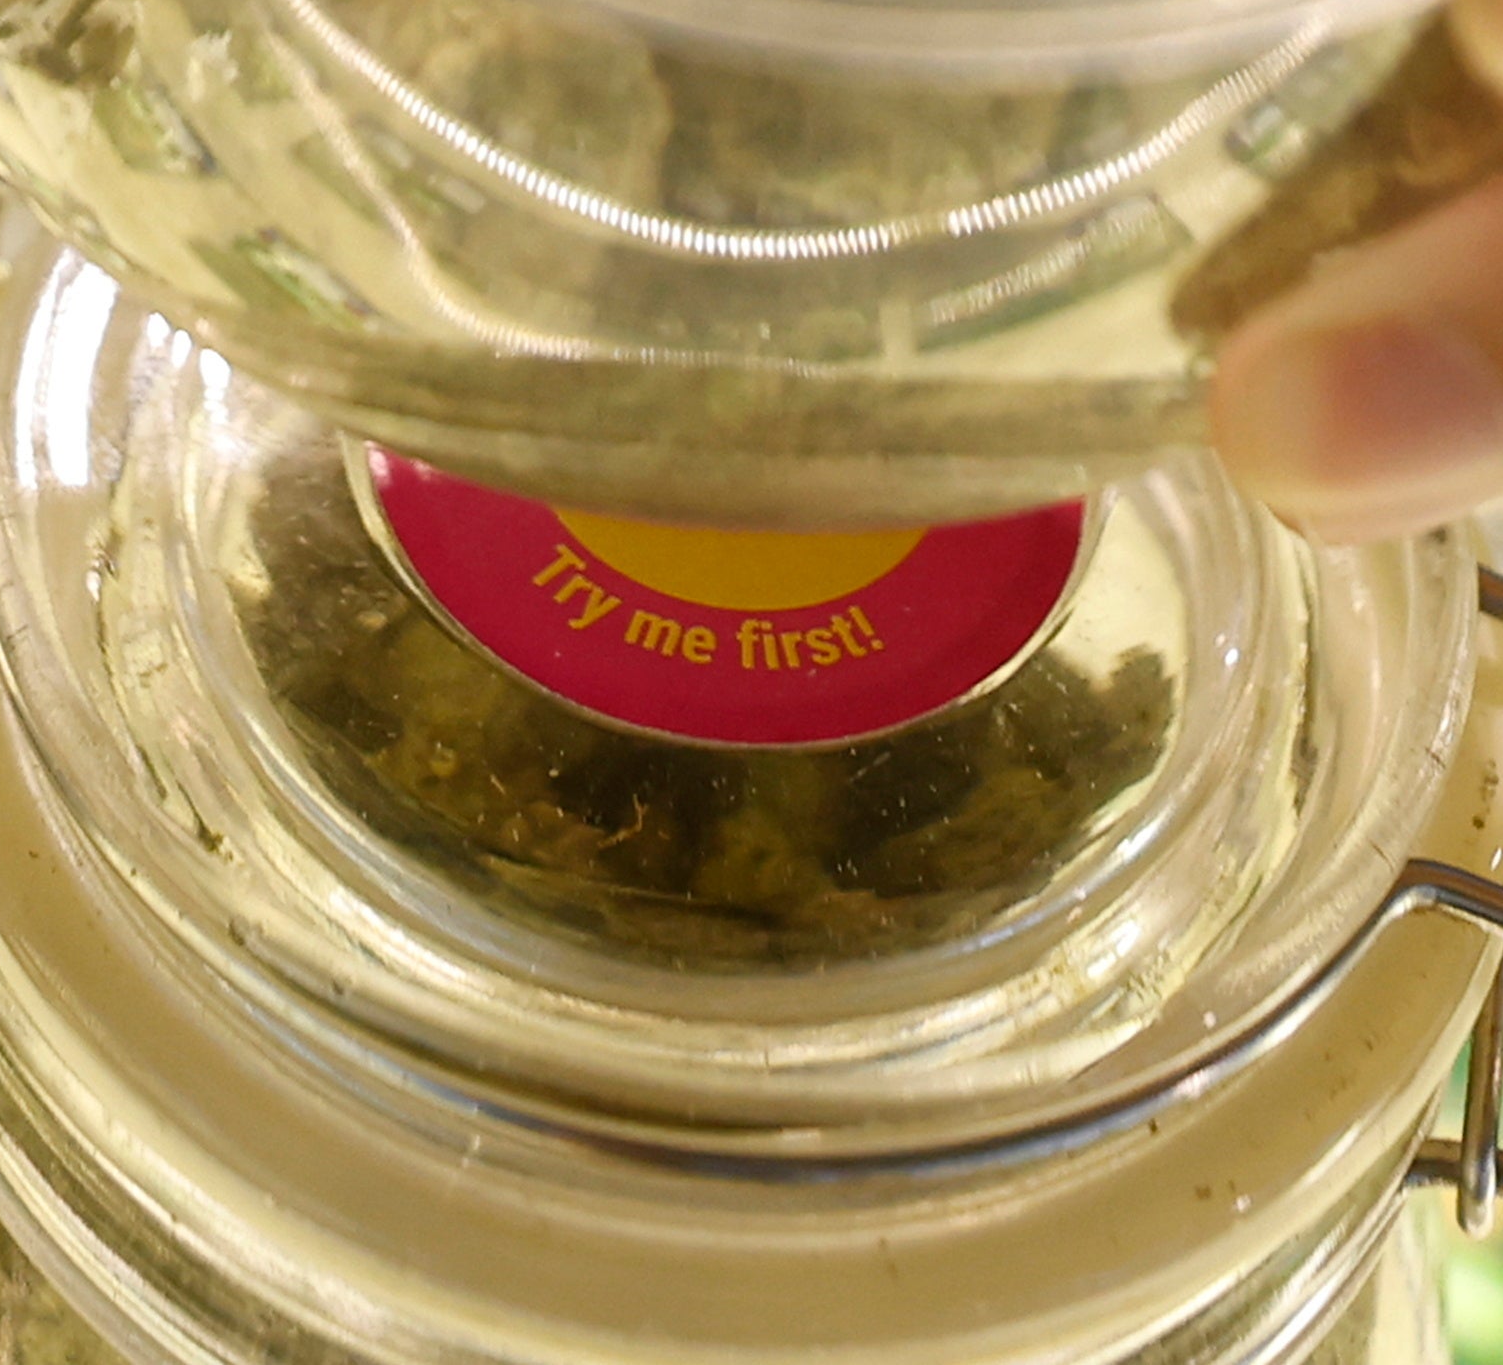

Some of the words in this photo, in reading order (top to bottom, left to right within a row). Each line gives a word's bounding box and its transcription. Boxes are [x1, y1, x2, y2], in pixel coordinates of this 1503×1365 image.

[532, 543, 623, 630] Try
[623, 608, 718, 664] me
[736, 604, 884, 669] first!
